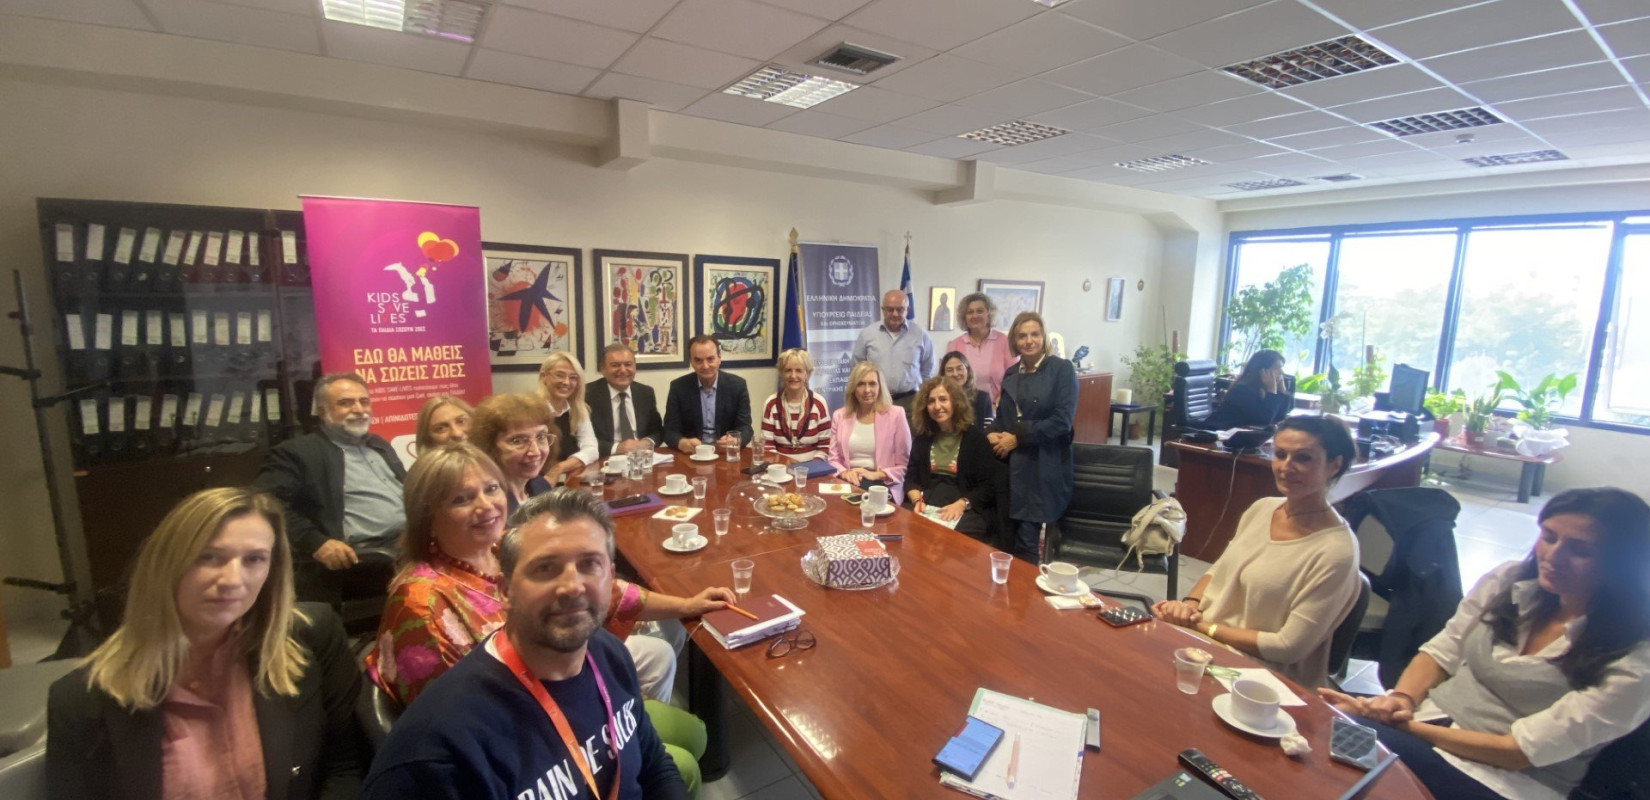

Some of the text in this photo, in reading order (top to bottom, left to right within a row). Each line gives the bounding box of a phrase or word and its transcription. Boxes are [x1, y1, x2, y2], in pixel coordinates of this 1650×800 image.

[367, 292, 400, 303] KIDS
[354, 345, 463, 365] ΕΔΩ ΘΑ ΜΑΘΕΙΣ
[355, 363, 466, 384] ΝΑ ΣΩΖΕΙΣ ΖΩΕΣ
